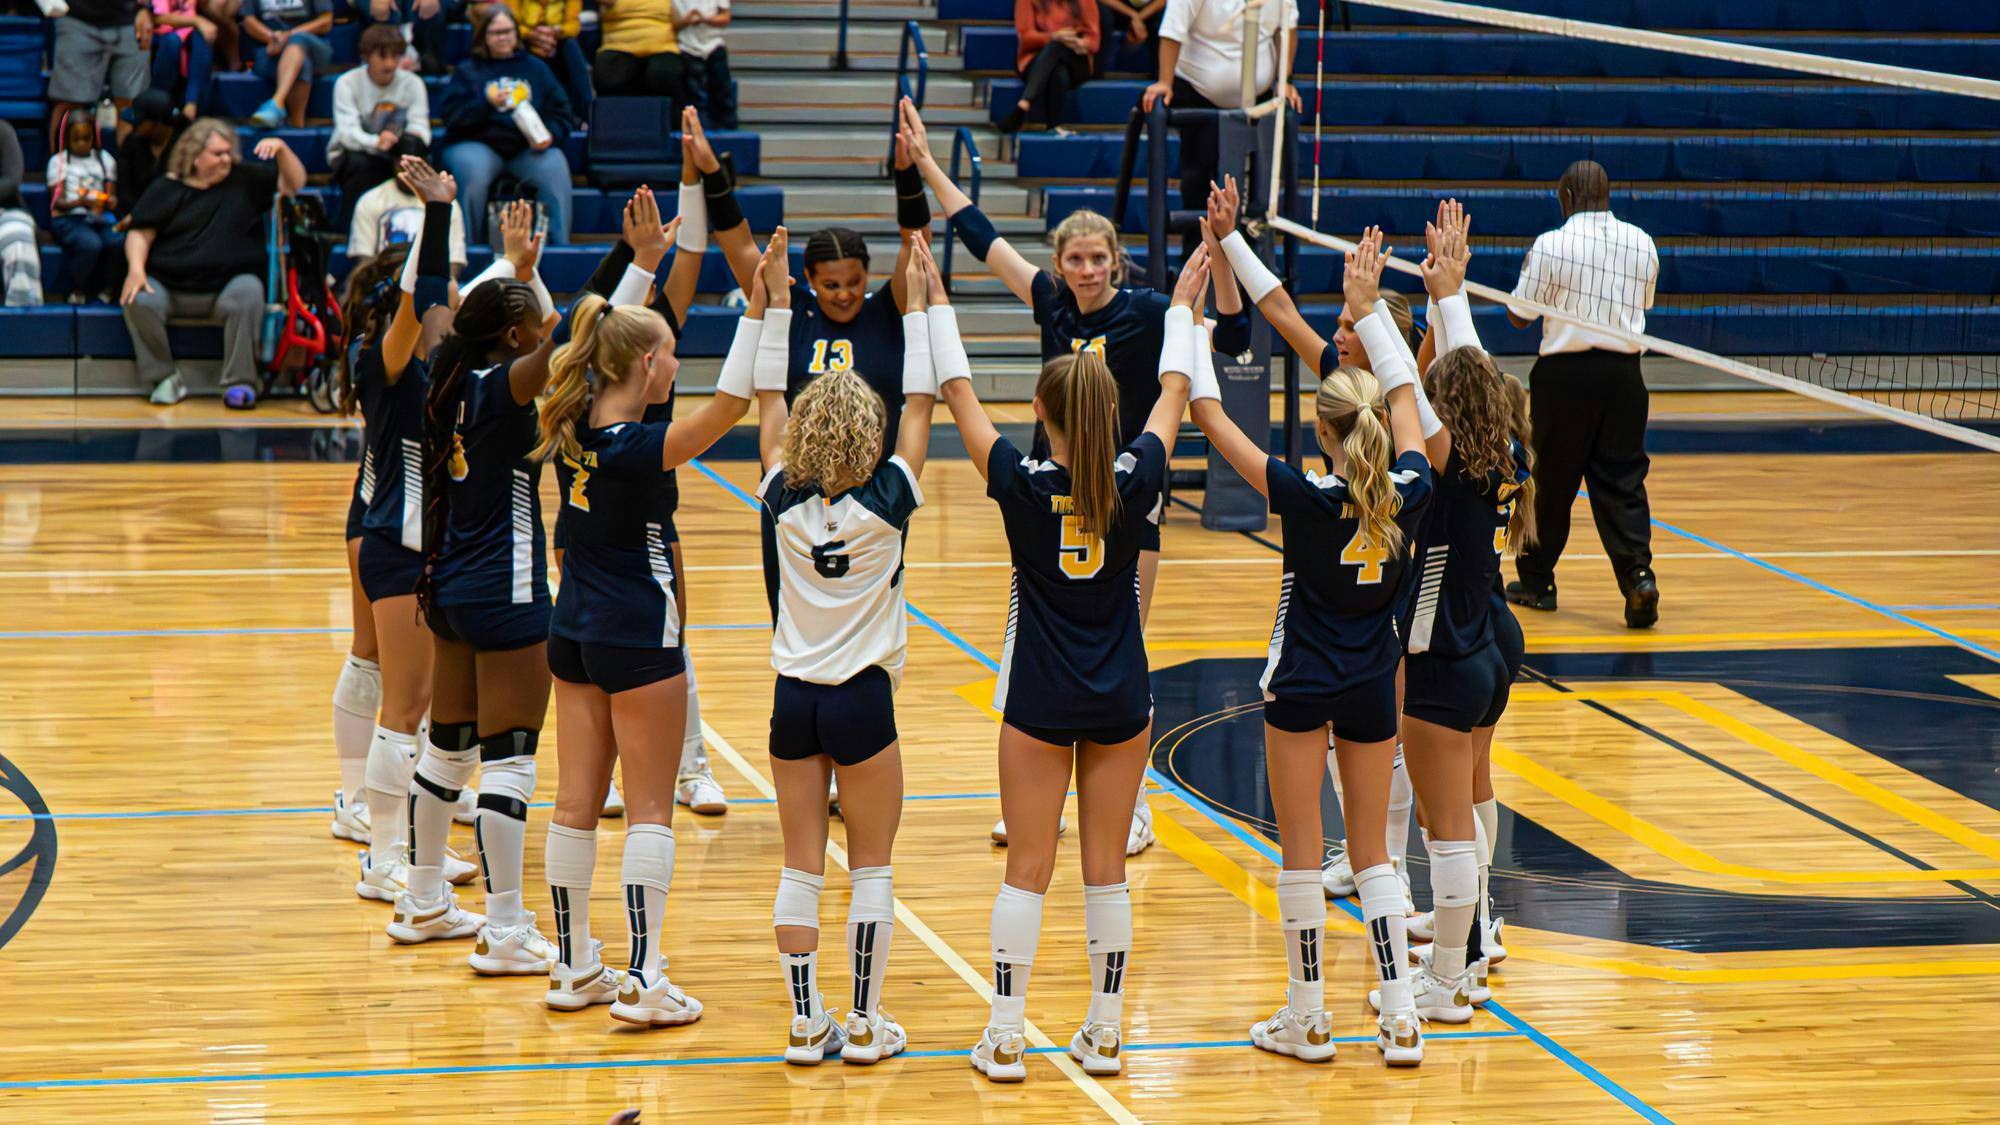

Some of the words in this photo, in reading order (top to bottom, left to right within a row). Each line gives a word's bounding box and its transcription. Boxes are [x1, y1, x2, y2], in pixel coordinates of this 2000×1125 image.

[808, 338, 854, 373] 13
[811, 539, 850, 578] 6
[1059, 514, 1105, 580] 5
[1339, 521, 1390, 585] 4
